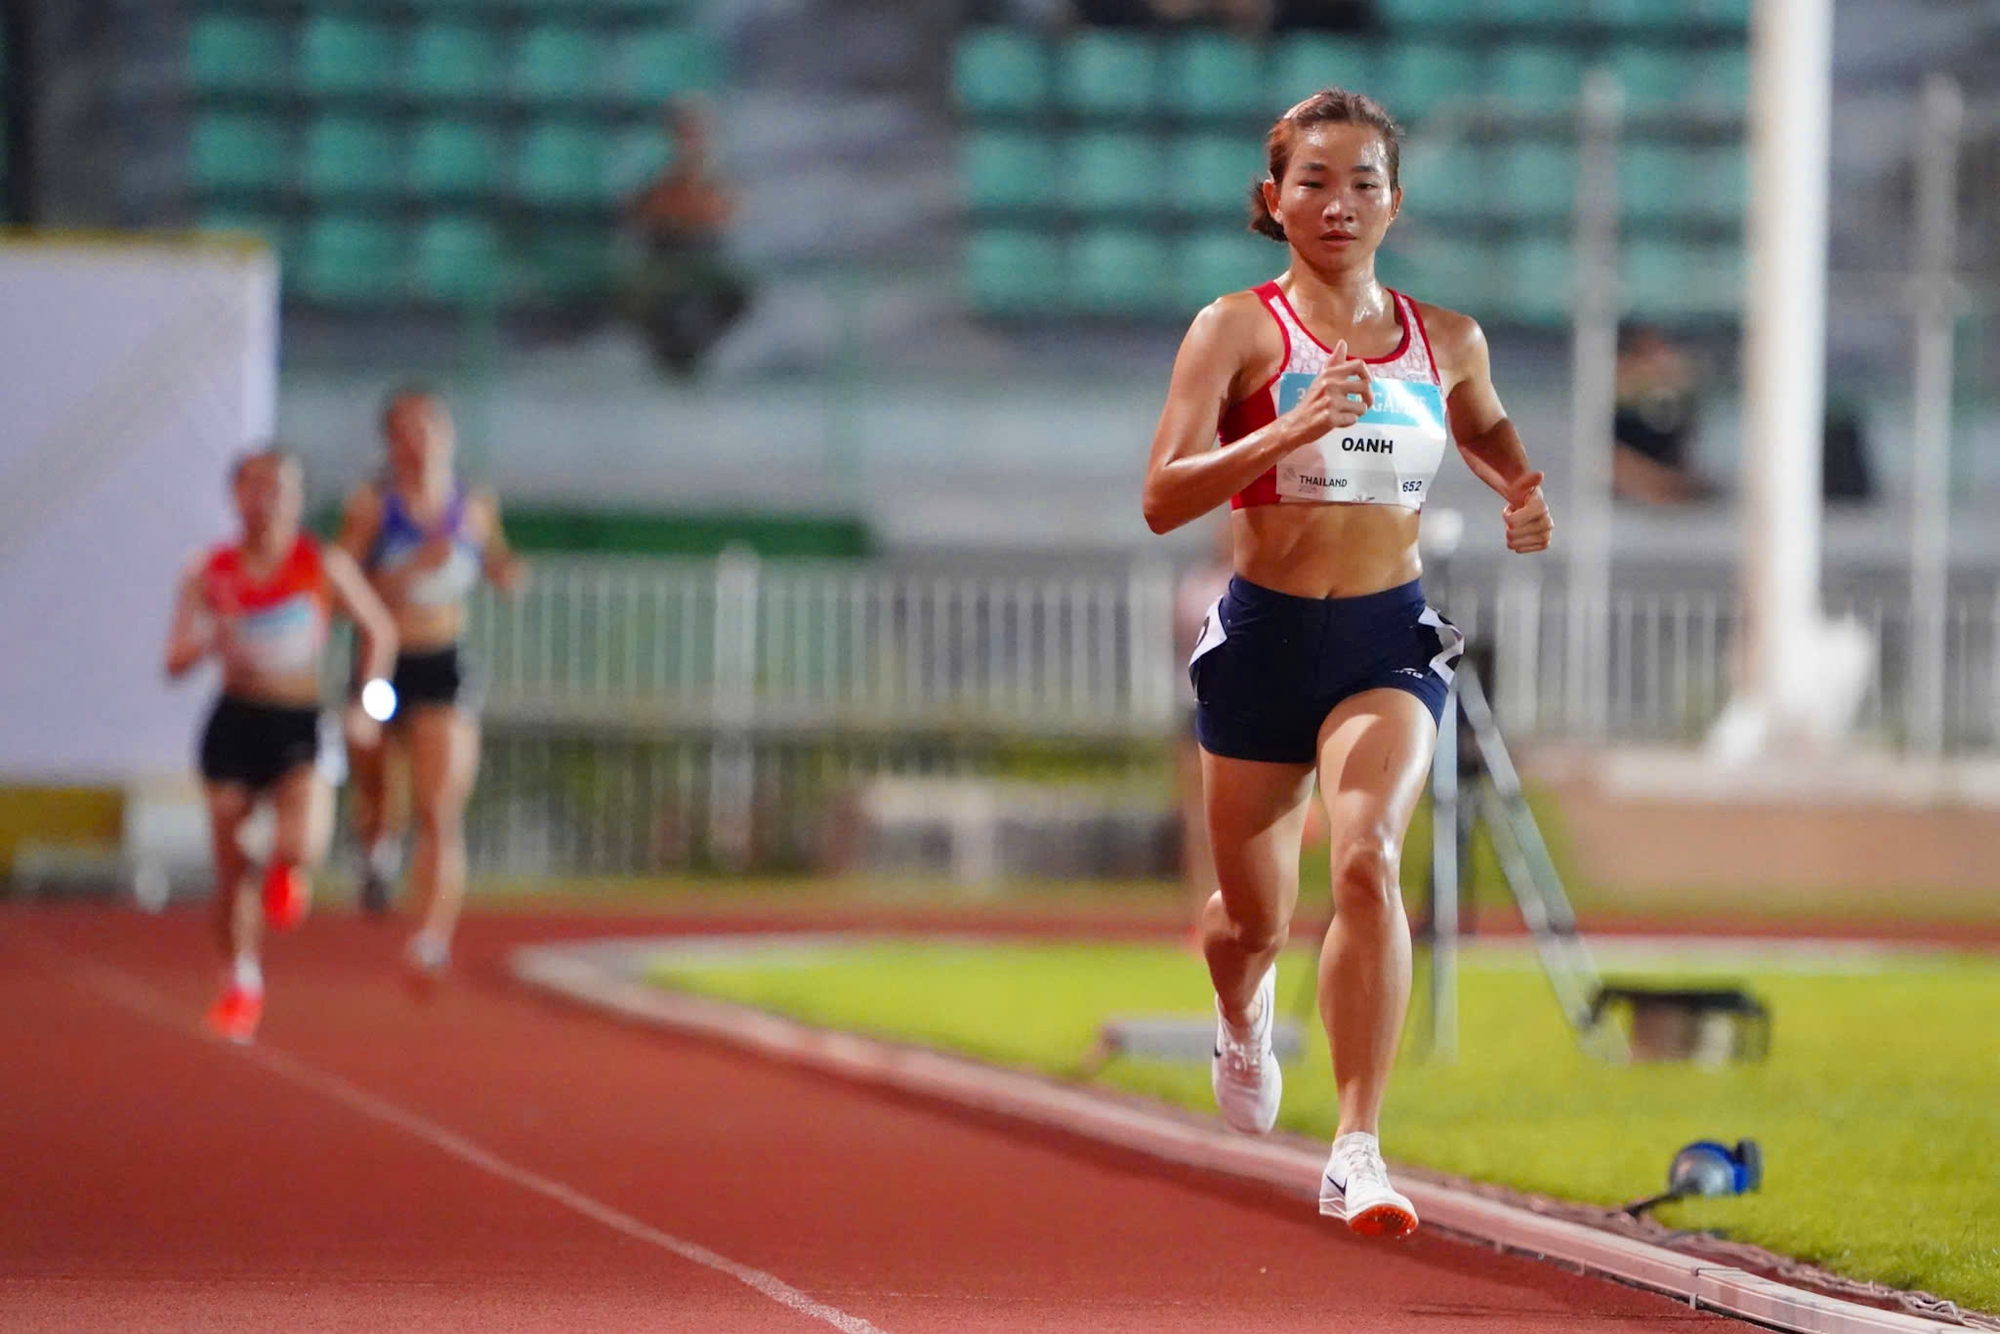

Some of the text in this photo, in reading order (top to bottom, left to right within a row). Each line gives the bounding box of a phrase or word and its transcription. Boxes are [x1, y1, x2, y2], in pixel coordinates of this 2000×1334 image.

[1341, 437, 1394, 454] OANH
[1299, 475, 1348, 488] THAILAND
[1402, 480, 1422, 492] 652
